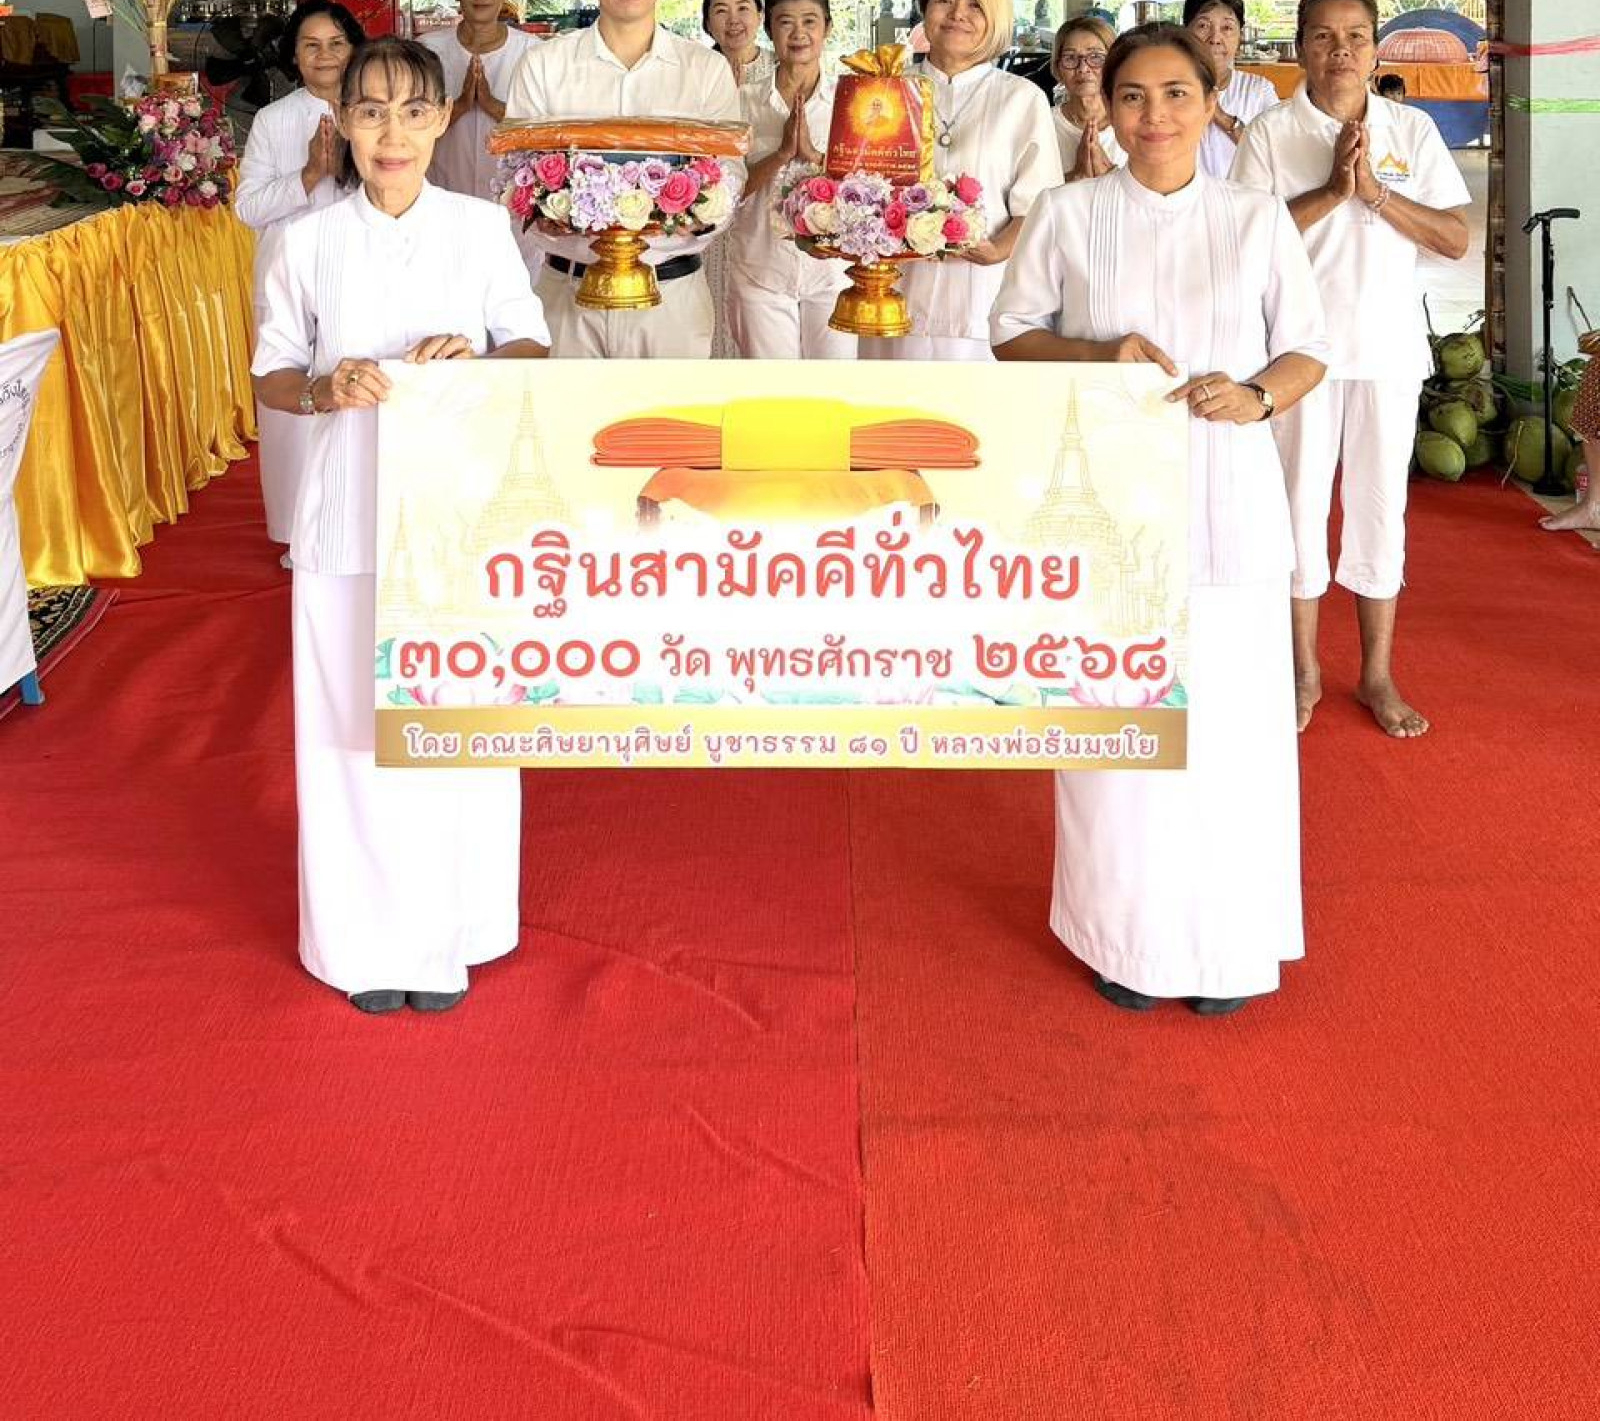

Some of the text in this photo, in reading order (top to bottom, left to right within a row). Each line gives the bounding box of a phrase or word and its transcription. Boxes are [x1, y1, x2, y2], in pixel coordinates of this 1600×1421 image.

[485, 512, 1081, 618] กฐินสามัคคีทั่วไทย
[399, 633, 1169, 693] ๓๐,๐๐๐ วัด พุทธศักราช ๒๕๖๘
[405, 725, 1157, 764] โดย คณะศิษยานุศิษย์ บูชาธรรม ๘๑ ปี หลวงพ่อธัมมชโย
